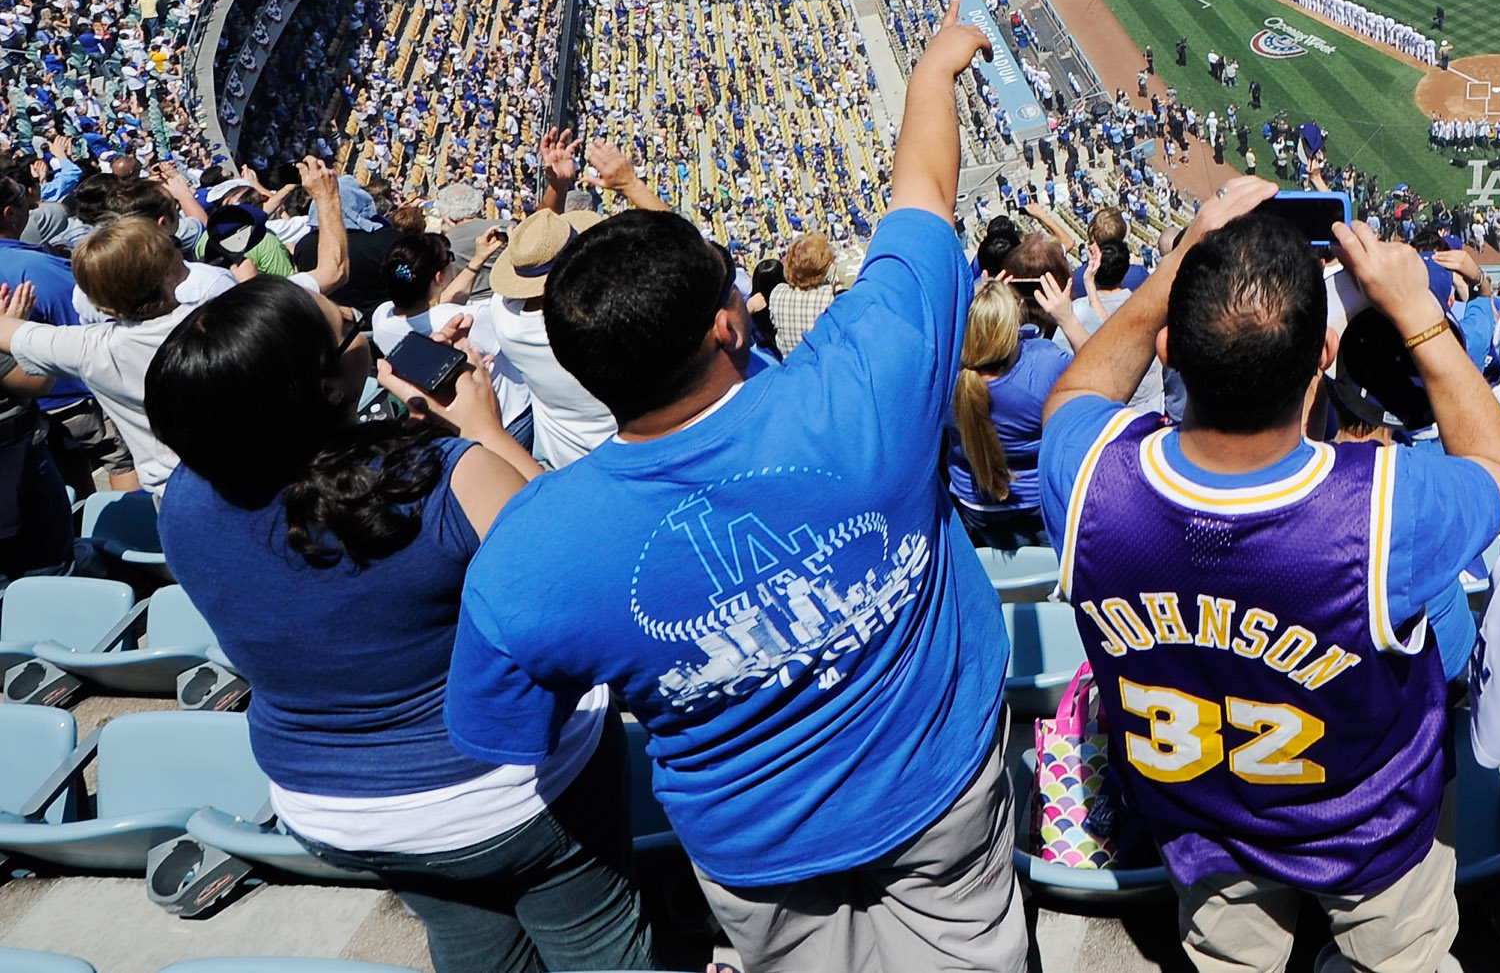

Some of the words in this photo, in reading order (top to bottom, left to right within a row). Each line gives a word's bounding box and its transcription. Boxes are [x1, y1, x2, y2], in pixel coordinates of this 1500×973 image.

[991, 43, 1019, 85] STADIUM
[1264, 16, 1308, 42] Opening
[1303, 34, 1337, 55] Week
[666, 497, 834, 610] LA
[1080, 592, 1362, 691] JOHNSON
[1118, 676, 1326, 785] 32
